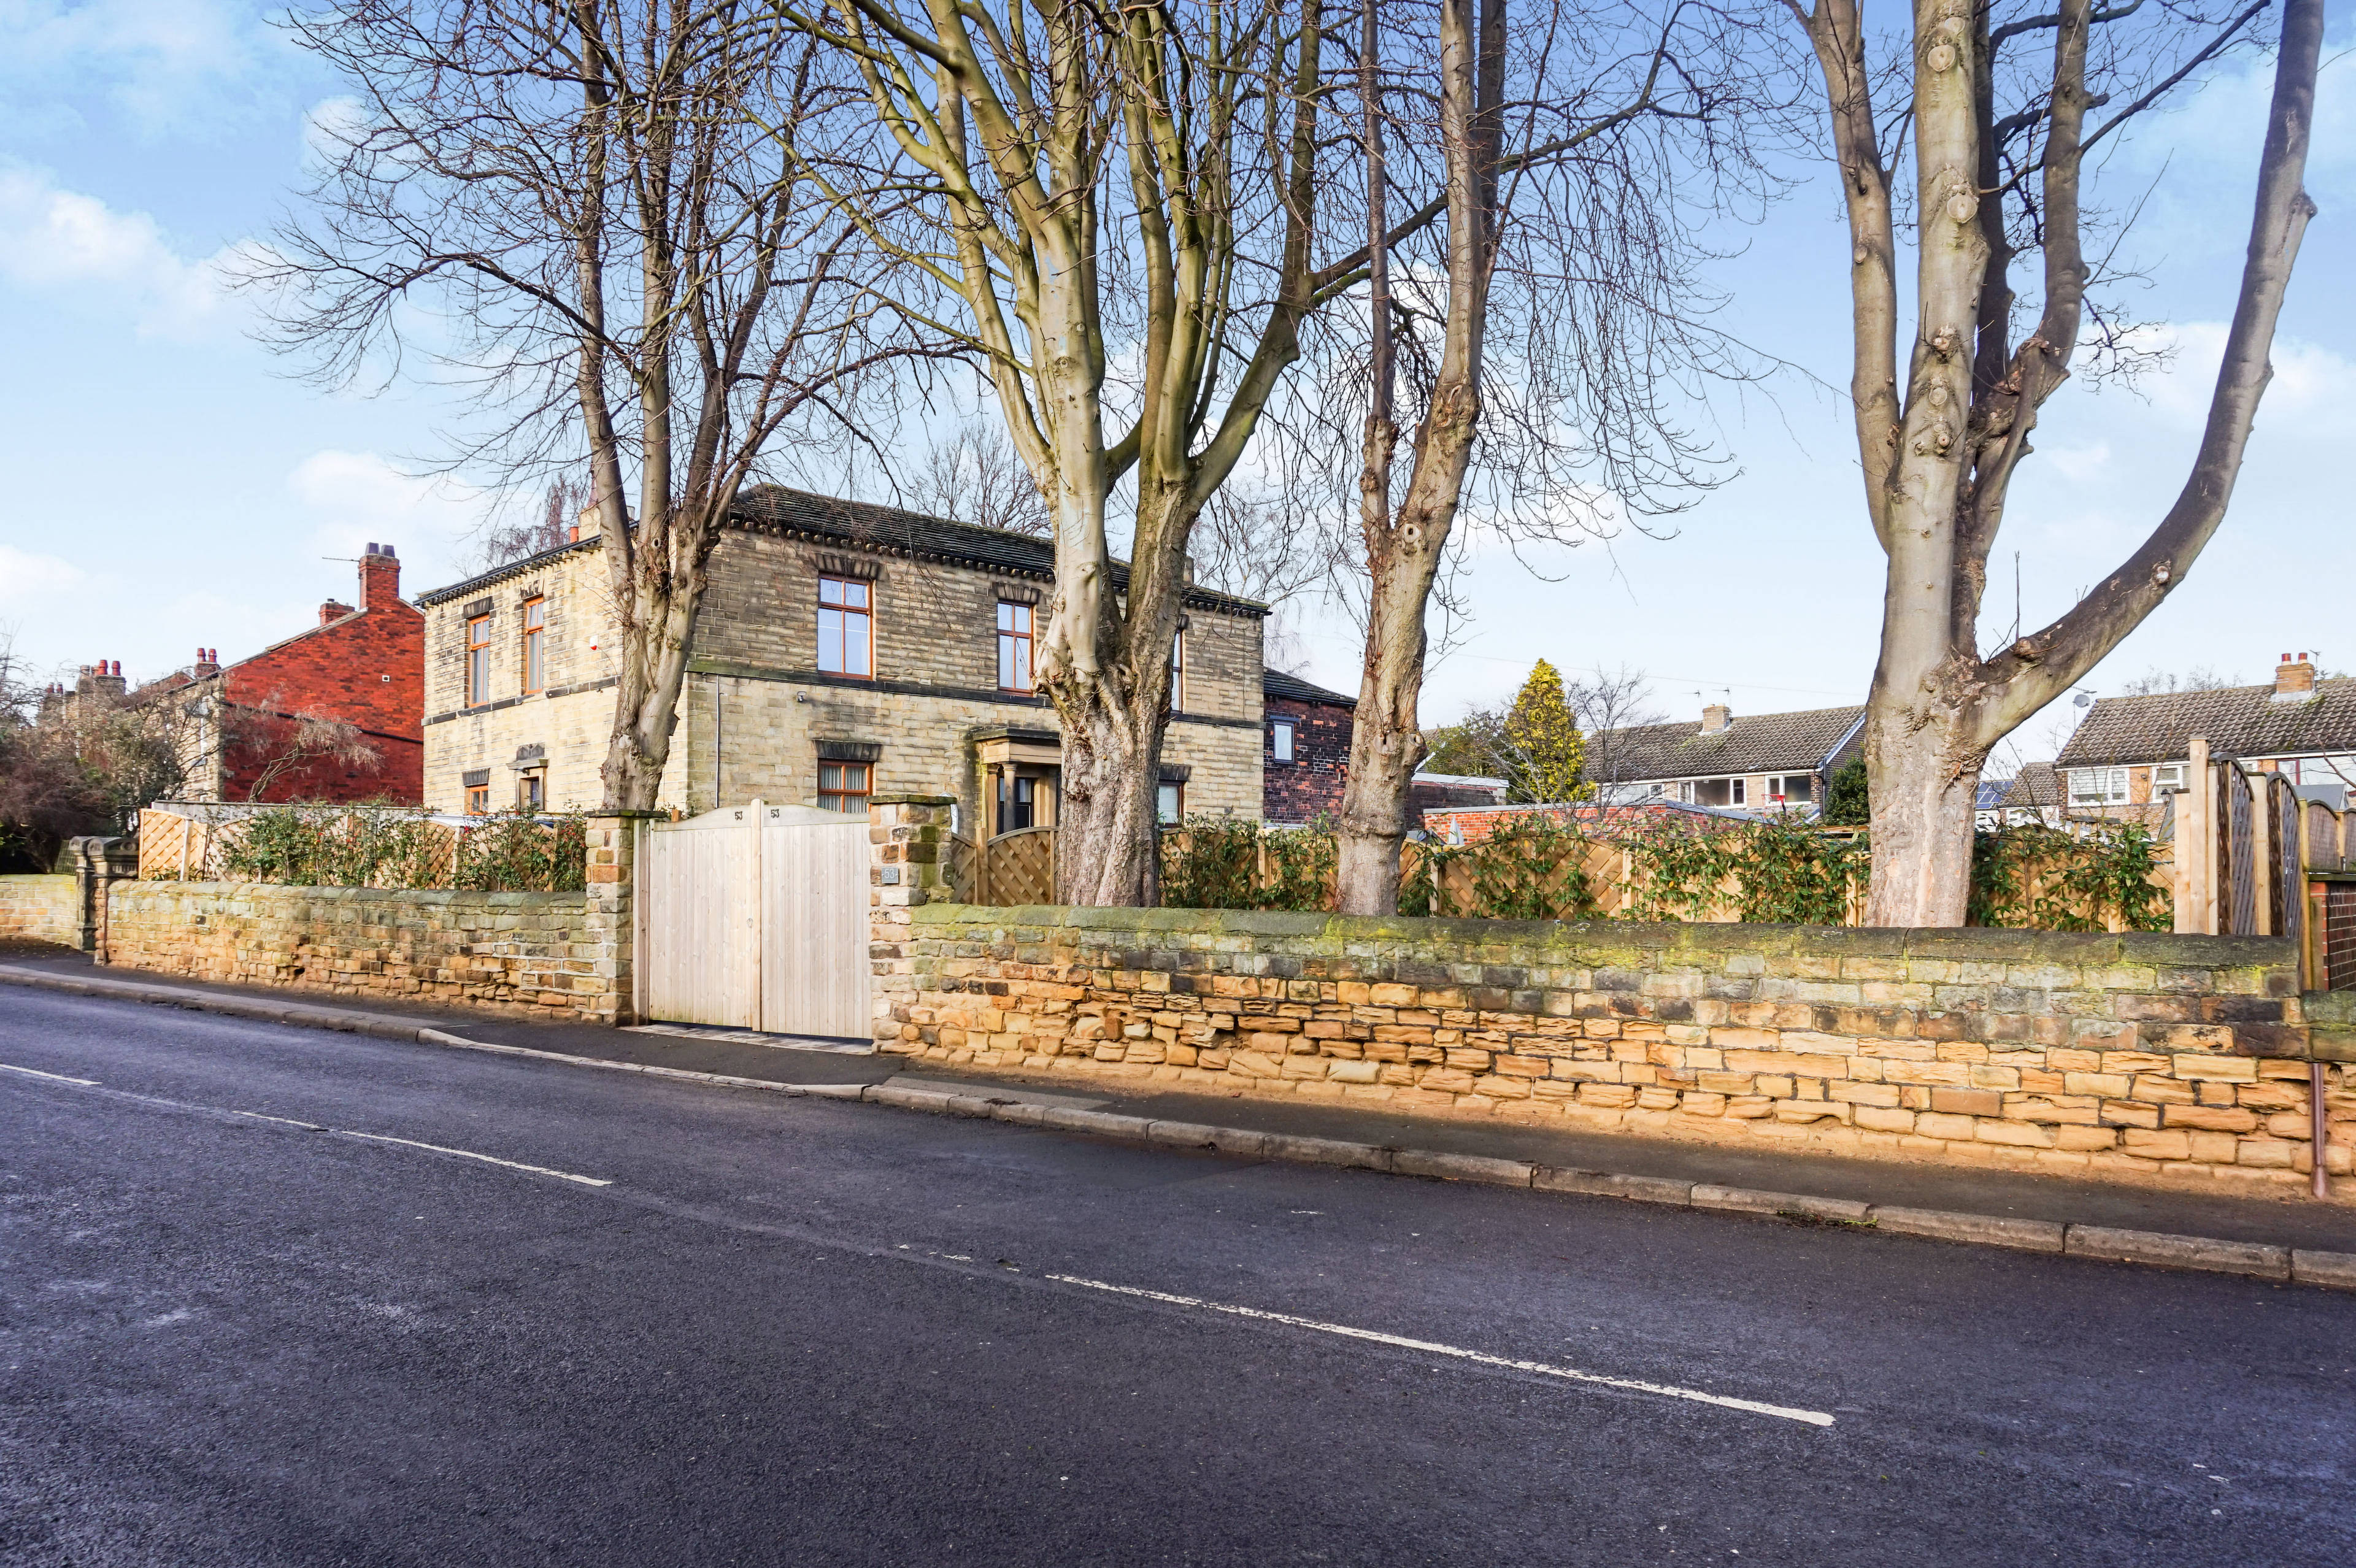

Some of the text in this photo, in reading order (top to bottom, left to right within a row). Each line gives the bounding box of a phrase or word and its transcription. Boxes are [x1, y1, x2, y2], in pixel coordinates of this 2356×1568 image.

[734, 811, 743, 820] 53
[771, 809, 780, 818] 53
[884, 869, 895, 878] 53
